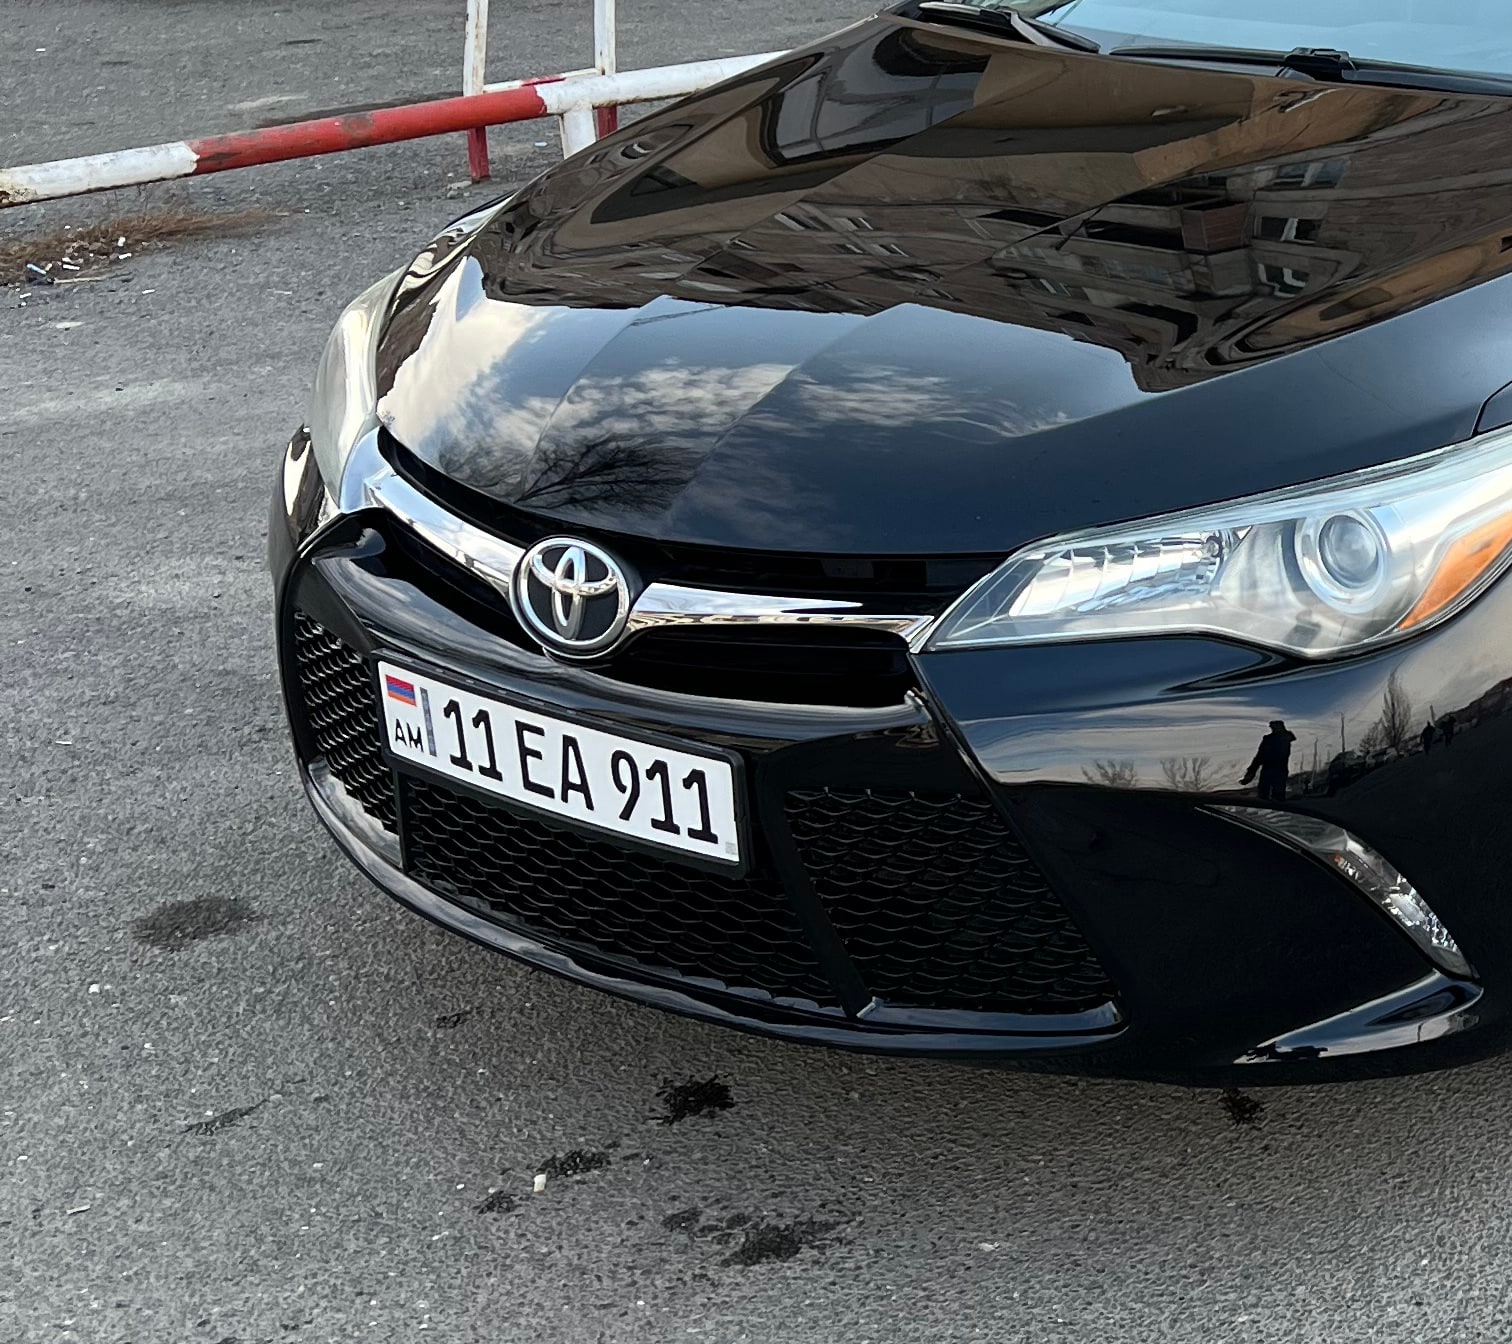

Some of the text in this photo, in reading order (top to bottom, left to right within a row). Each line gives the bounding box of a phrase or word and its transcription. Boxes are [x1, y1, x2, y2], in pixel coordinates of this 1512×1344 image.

[394, 718, 424, 753] AM
[443, 698, 719, 845] 11 EA 911
